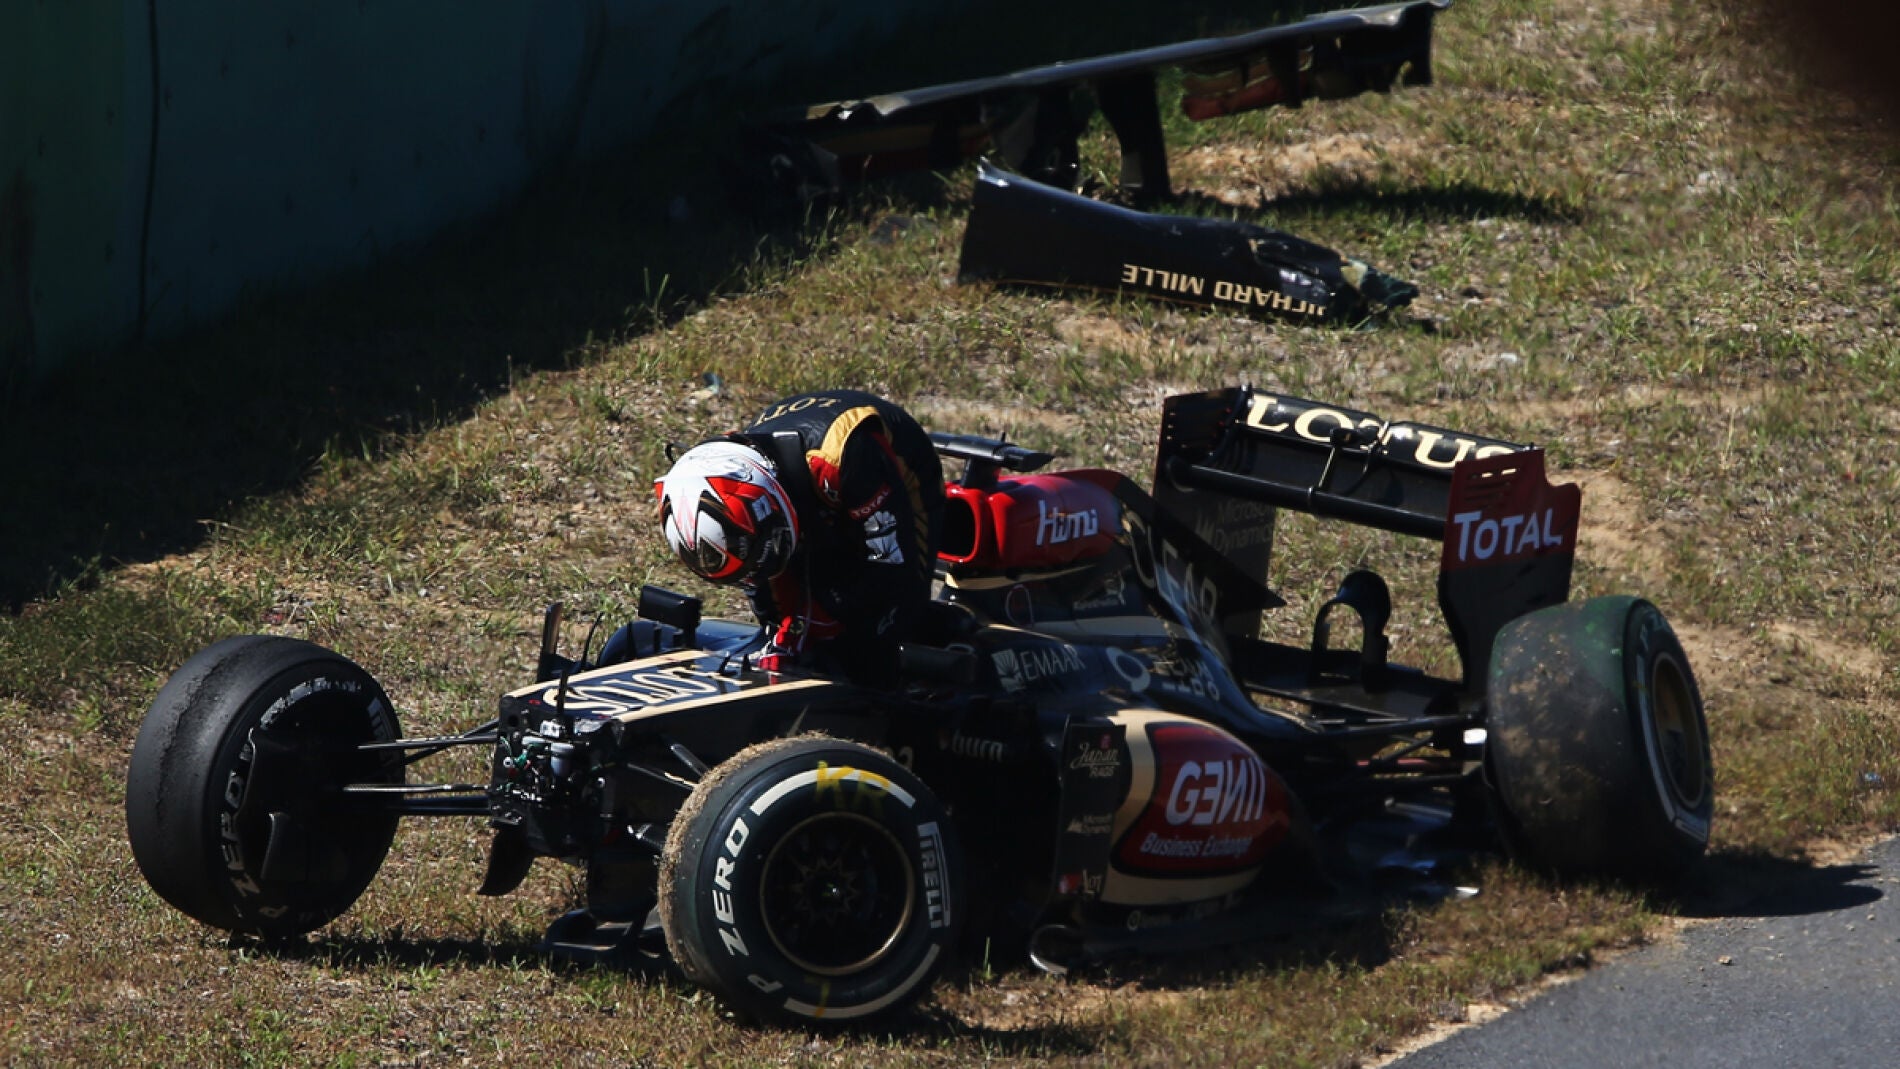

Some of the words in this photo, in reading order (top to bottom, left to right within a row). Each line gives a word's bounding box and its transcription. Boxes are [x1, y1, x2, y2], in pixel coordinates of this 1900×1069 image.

[1121, 263, 1205, 296] MILLE
[1453, 508, 1563, 562] TOTAL
[1019, 646, 1086, 682] EMAAR
[1139, 832, 1202, 858] Business
[711, 816, 751, 957] ZERO
[916, 820, 951, 929] PIRELLI
[747, 973, 784, 994] P
